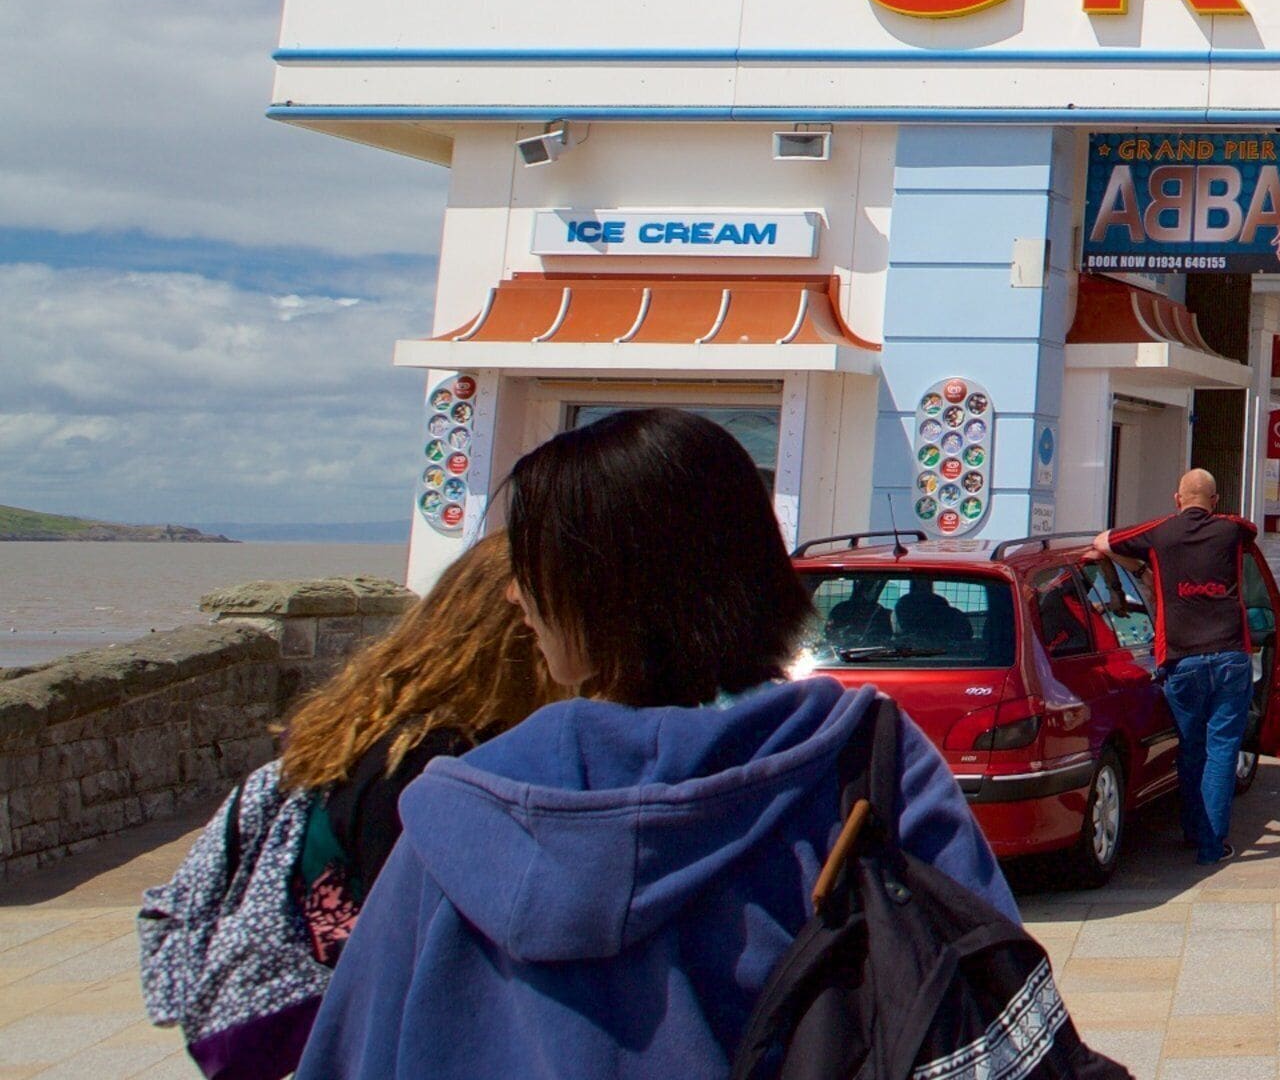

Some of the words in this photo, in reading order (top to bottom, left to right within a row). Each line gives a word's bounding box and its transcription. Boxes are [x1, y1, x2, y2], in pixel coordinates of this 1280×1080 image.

[1118, 139, 1214, 161] GRAND
[1224, 140, 1277, 161] PIER
[566, 220, 625, 244] ICE
[638, 221, 778, 245] CREAM
[1088, 255, 1118, 267] BOOK
[1120, 256, 1146, 267] NOW
[1148, 256, 1182, 268] 01934
[1185, 256, 1226, 268] 646155
